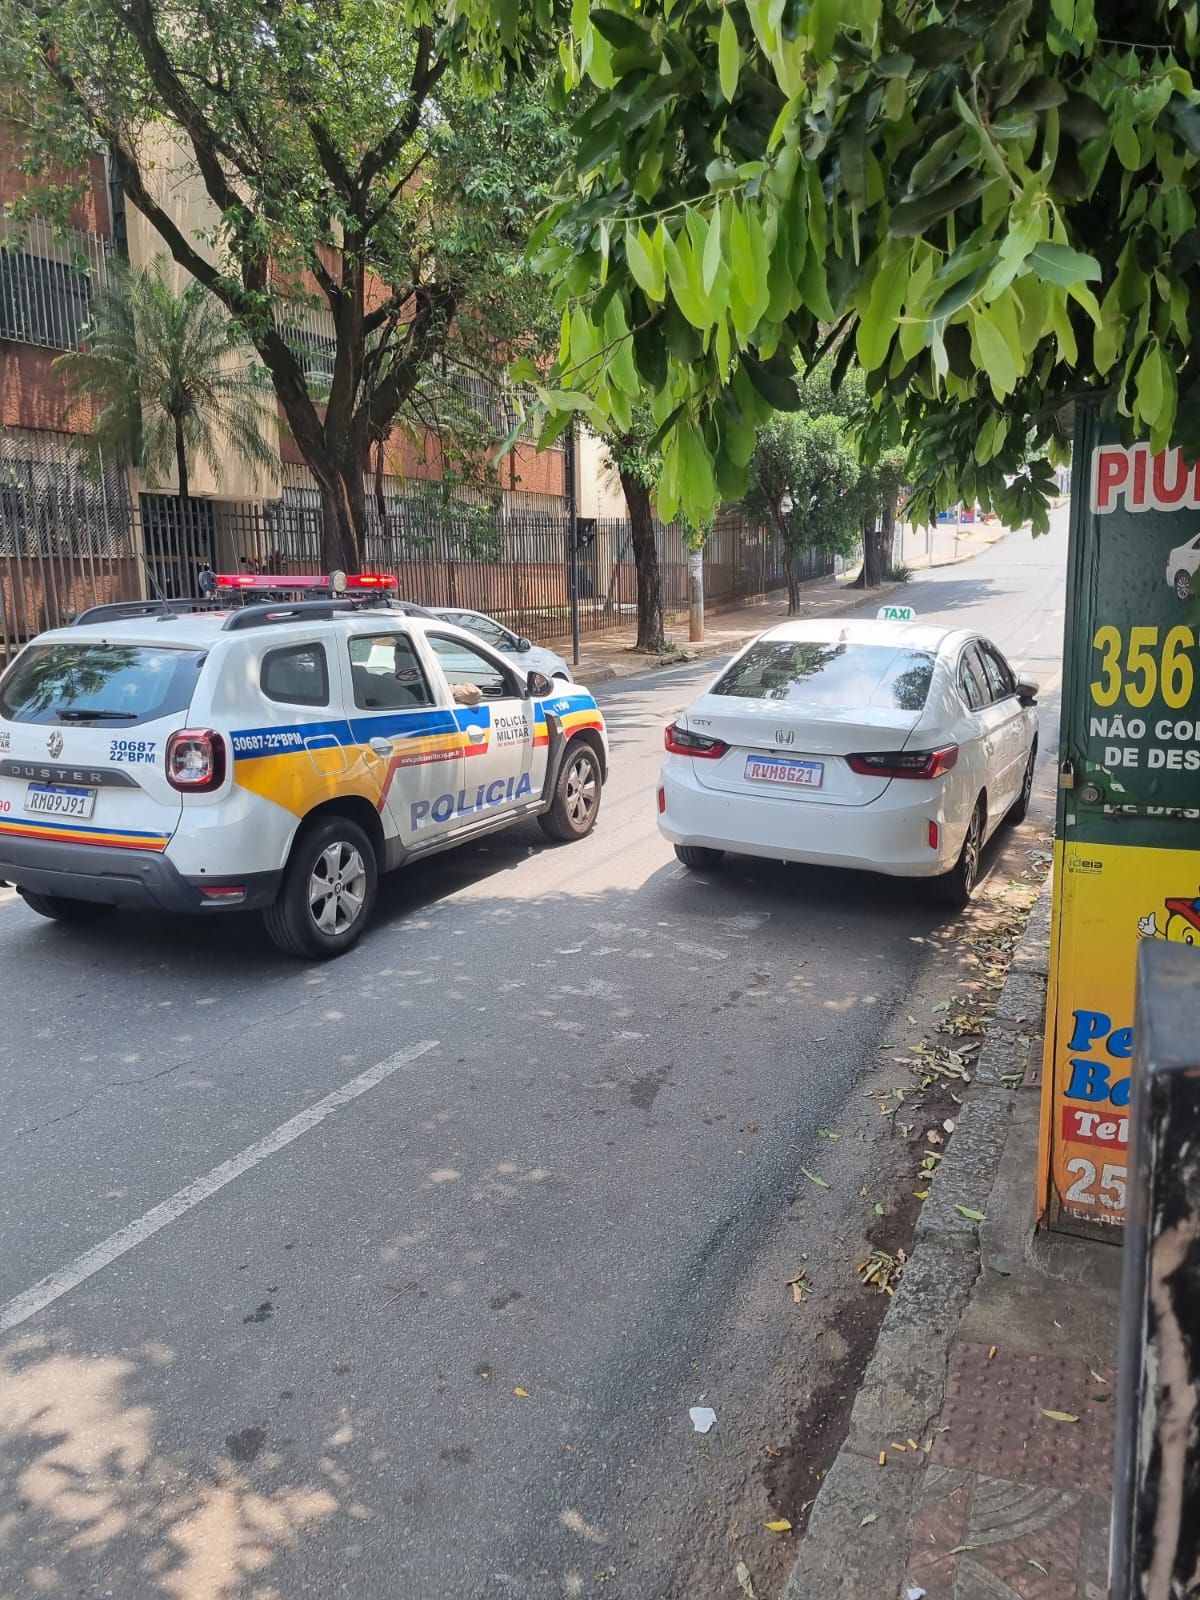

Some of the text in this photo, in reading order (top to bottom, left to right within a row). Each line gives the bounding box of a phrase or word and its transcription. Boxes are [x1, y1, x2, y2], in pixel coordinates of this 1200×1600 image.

[883, 607, 911, 620] TAXI
[1090, 625, 1195, 709] 356
[496, 727, 529, 742] MILITAR
[1089, 714, 1146, 739] NÃO
[110, 740, 156, 752] 30687
[1104, 746, 1200, 770] DE DES
[11, 766, 102, 782] DUSTER
[752, 763, 813, 783] RVH8G21
[30, 793, 85, 814] RMQ9J91
[1067, 1009, 1133, 1059] Pe
[1065, 1158, 1127, 1210] 25
